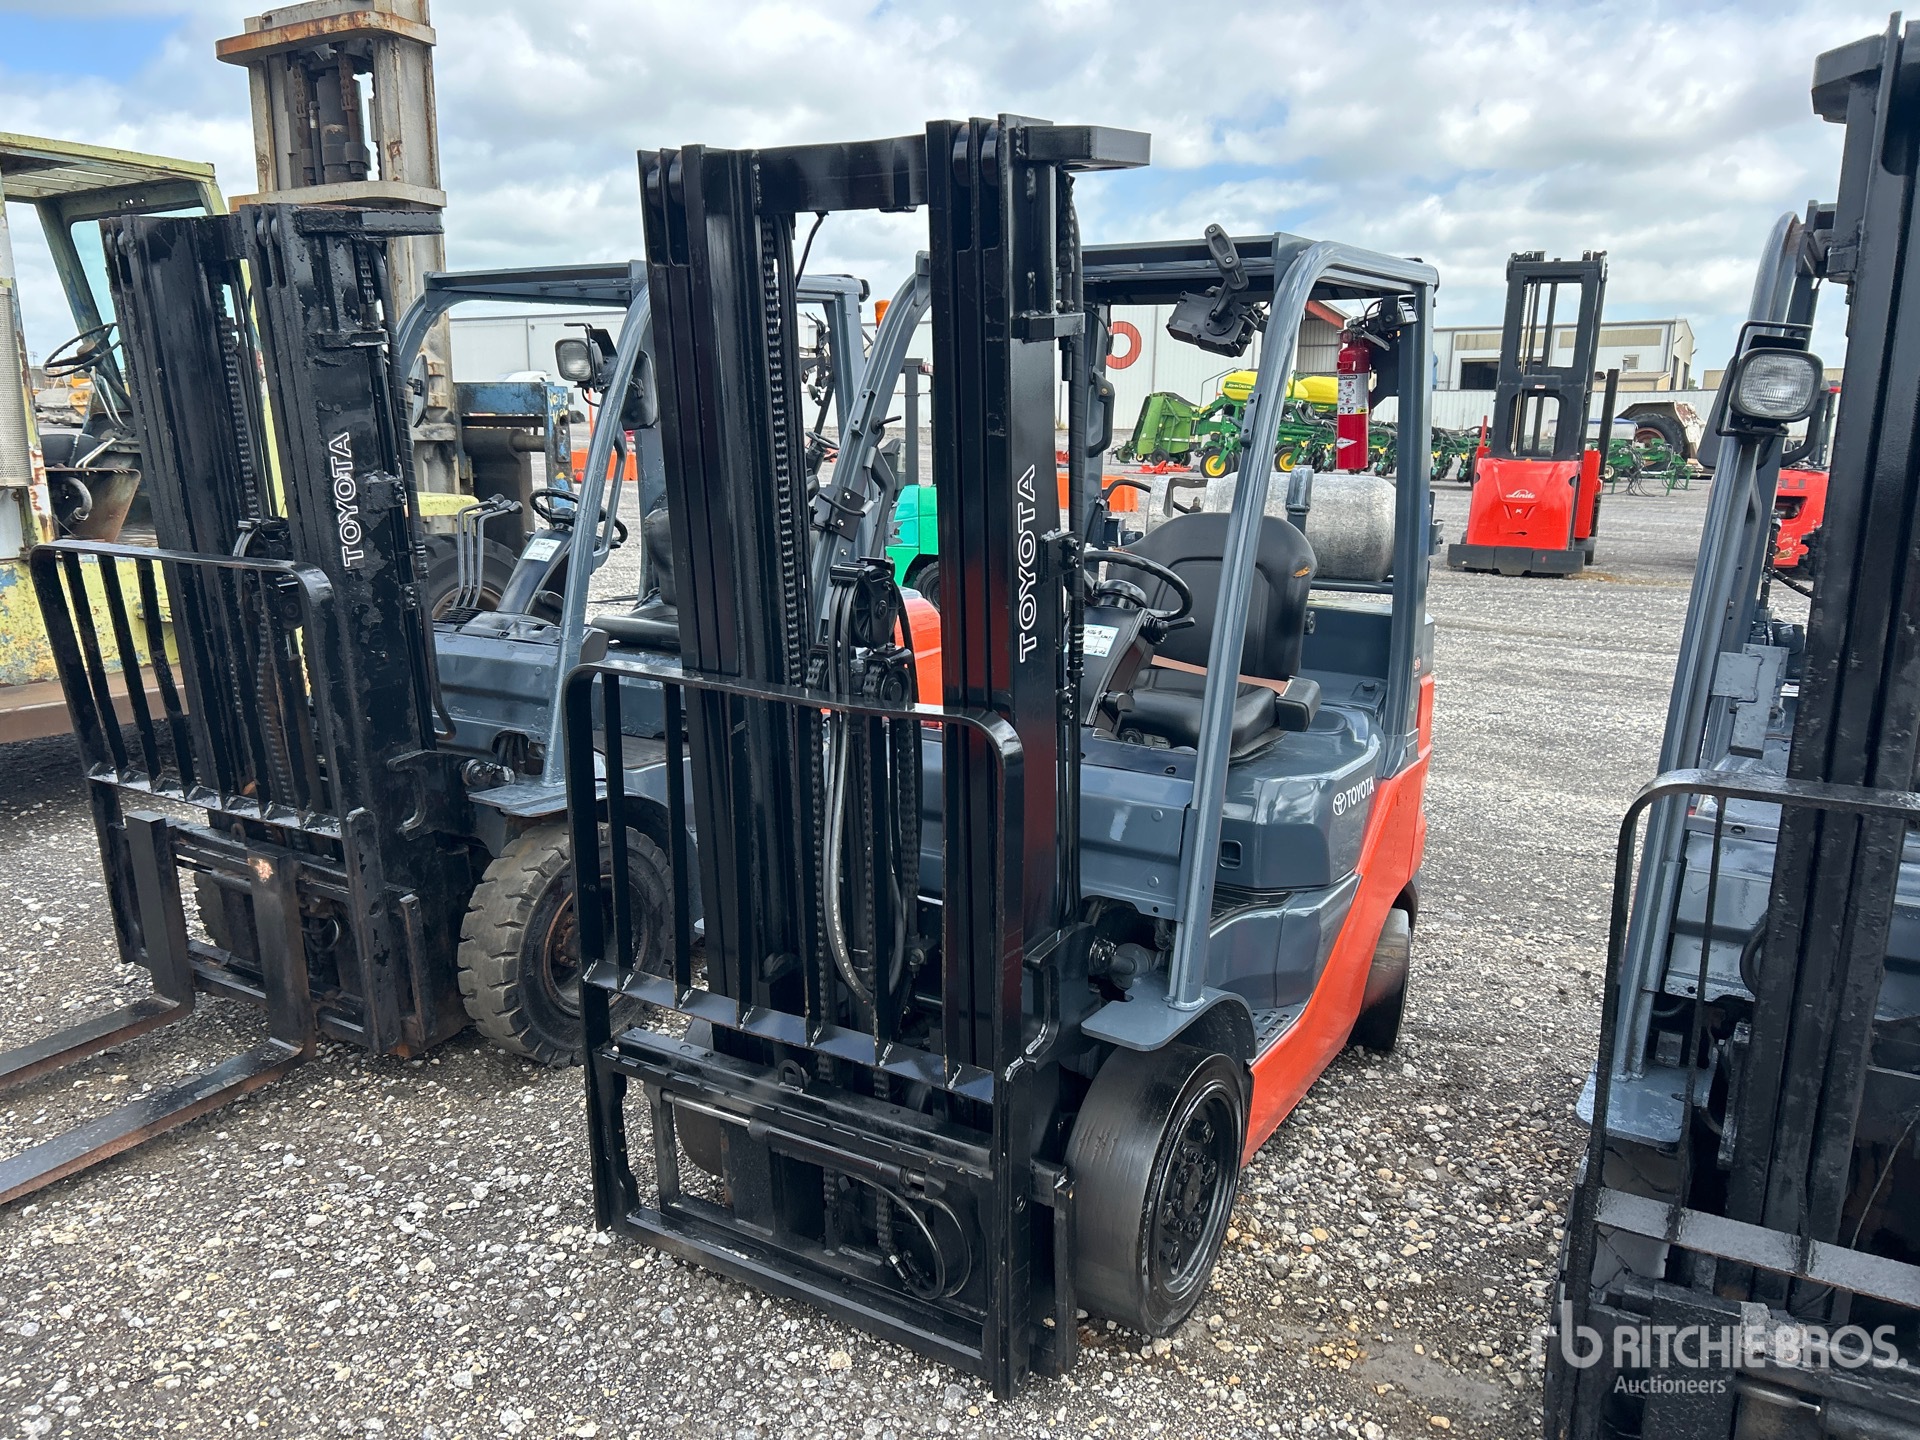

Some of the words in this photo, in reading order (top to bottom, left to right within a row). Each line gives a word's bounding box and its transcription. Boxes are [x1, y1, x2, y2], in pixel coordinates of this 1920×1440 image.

[328, 431, 365, 568] TOYOTA
[1505, 489, 1536, 499] Linde
[1017, 464, 1037, 664] TOYOTA
[1345, 775, 1375, 808] TOYOTA
